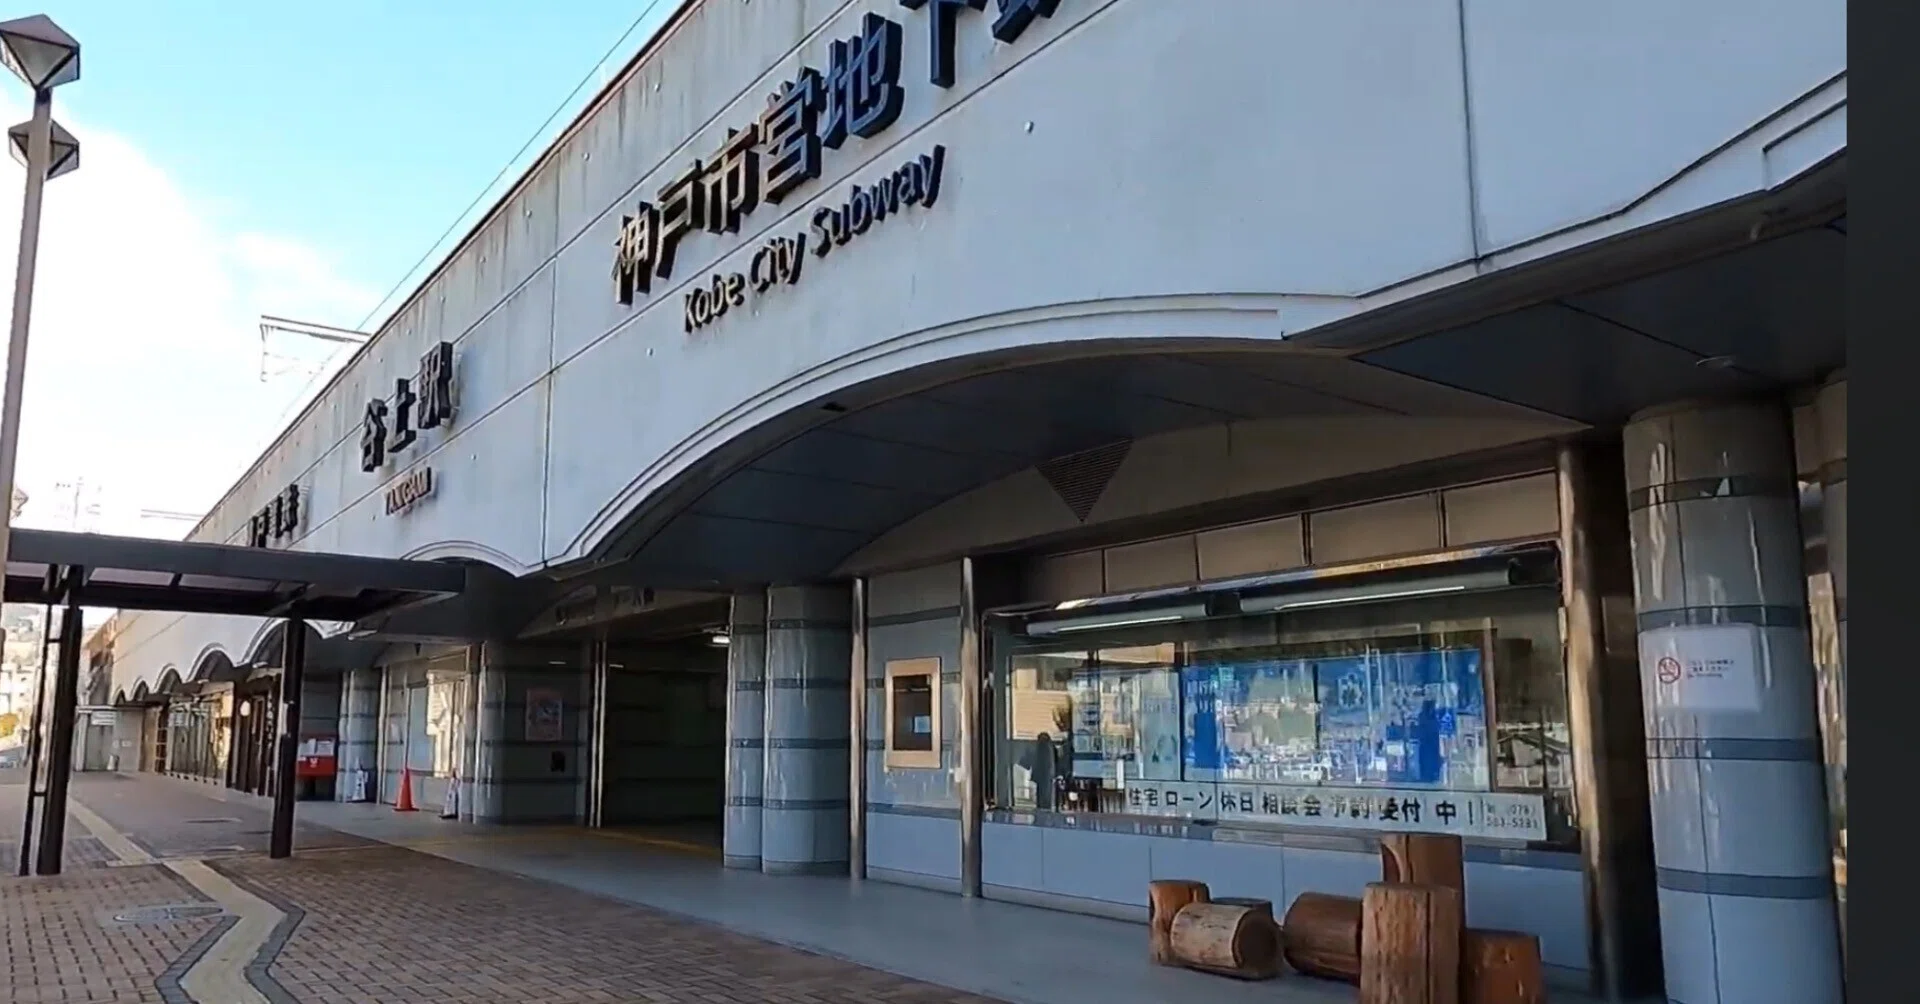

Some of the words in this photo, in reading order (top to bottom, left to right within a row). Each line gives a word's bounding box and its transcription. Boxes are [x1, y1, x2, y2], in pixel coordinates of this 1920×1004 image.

[612, 0, 1062, 305] 神戸市営地下
[685, 272, 745, 333] Kobe
[751, 232, 807, 293] City
[810, 145, 945, 258] Subway
[361, 341, 453, 472] 谷上駅
